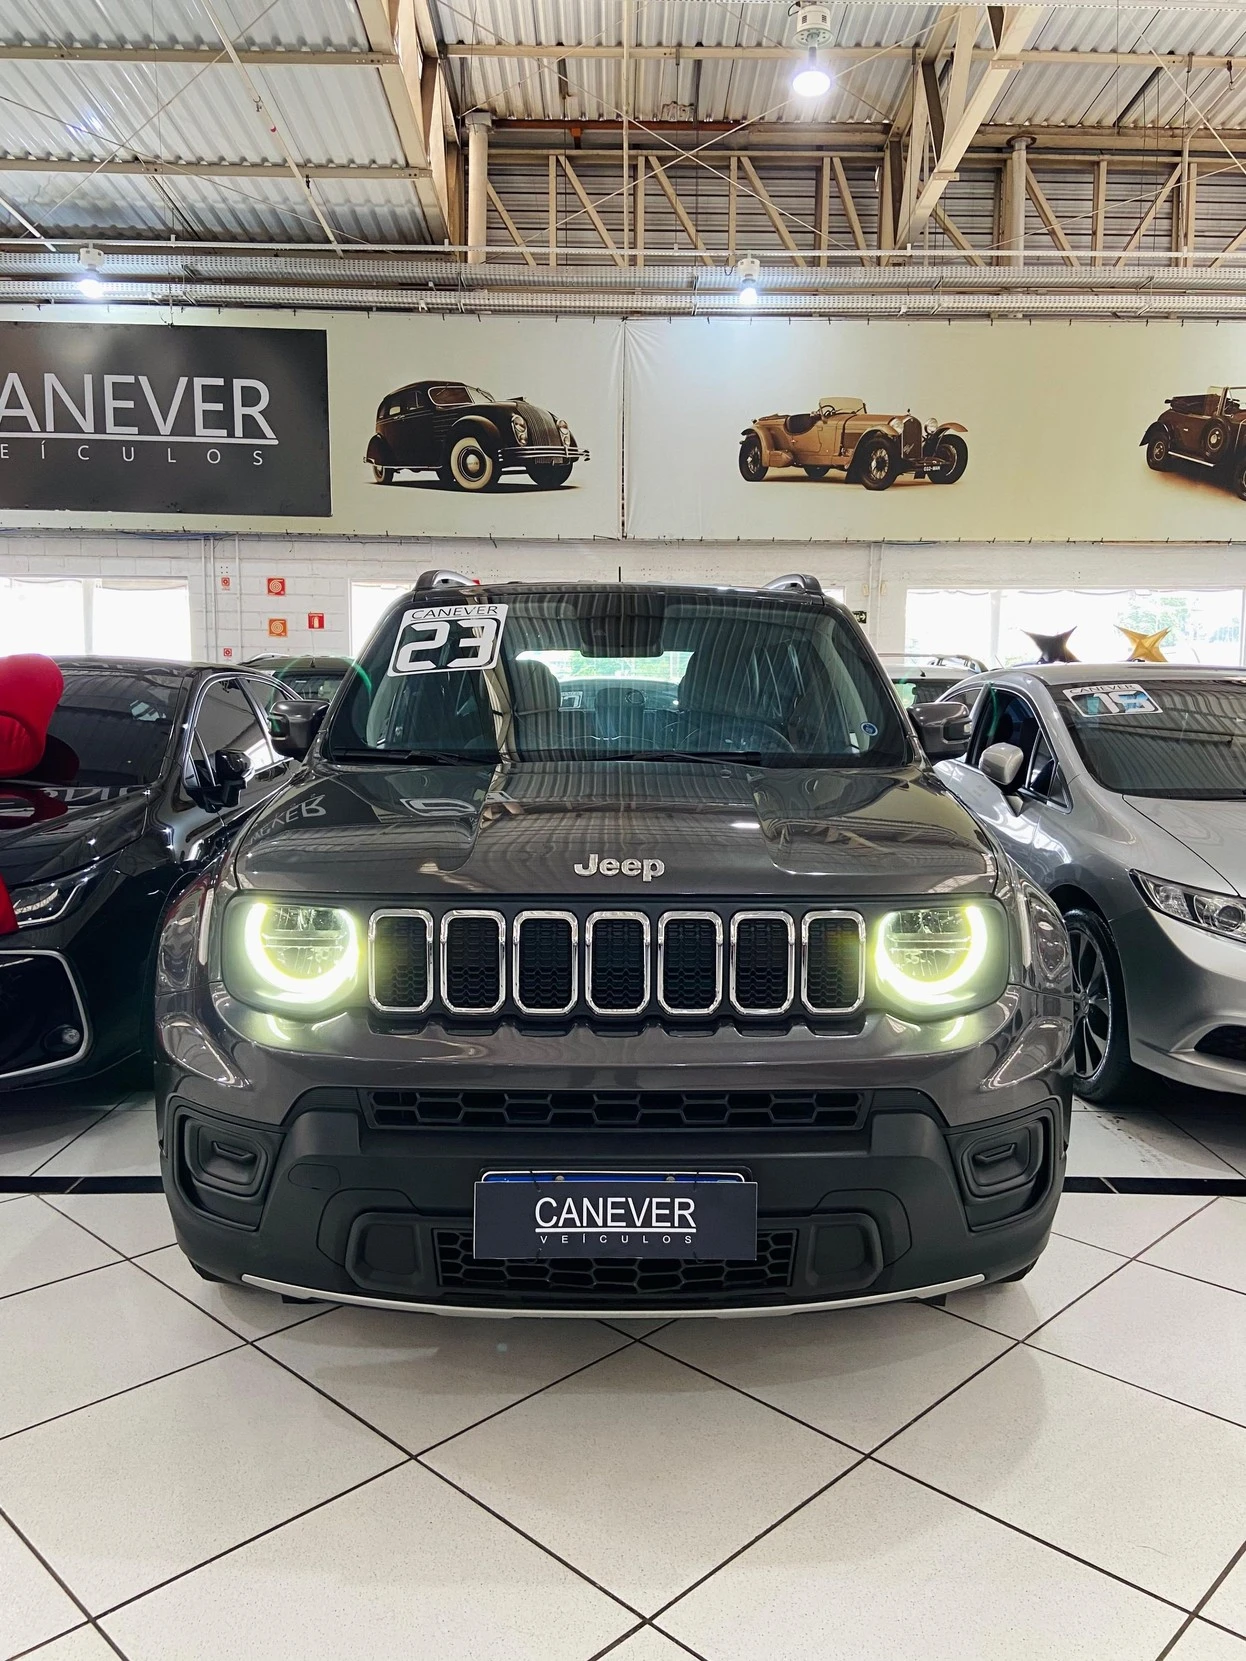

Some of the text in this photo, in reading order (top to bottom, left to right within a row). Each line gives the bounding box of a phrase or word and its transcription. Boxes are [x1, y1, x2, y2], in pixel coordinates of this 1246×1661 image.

[0, 372, 277, 439] ANEVER
[0, 440, 263, 465] EÍCULOS
[411, 605, 498, 620] CANEVER
[396, 619, 497, 671] 23
[574, 853, 665, 882] Jeep
[535, 1197, 697, 1228] CANEVER
[540, 1232, 692, 1245] VEÍCULOS
